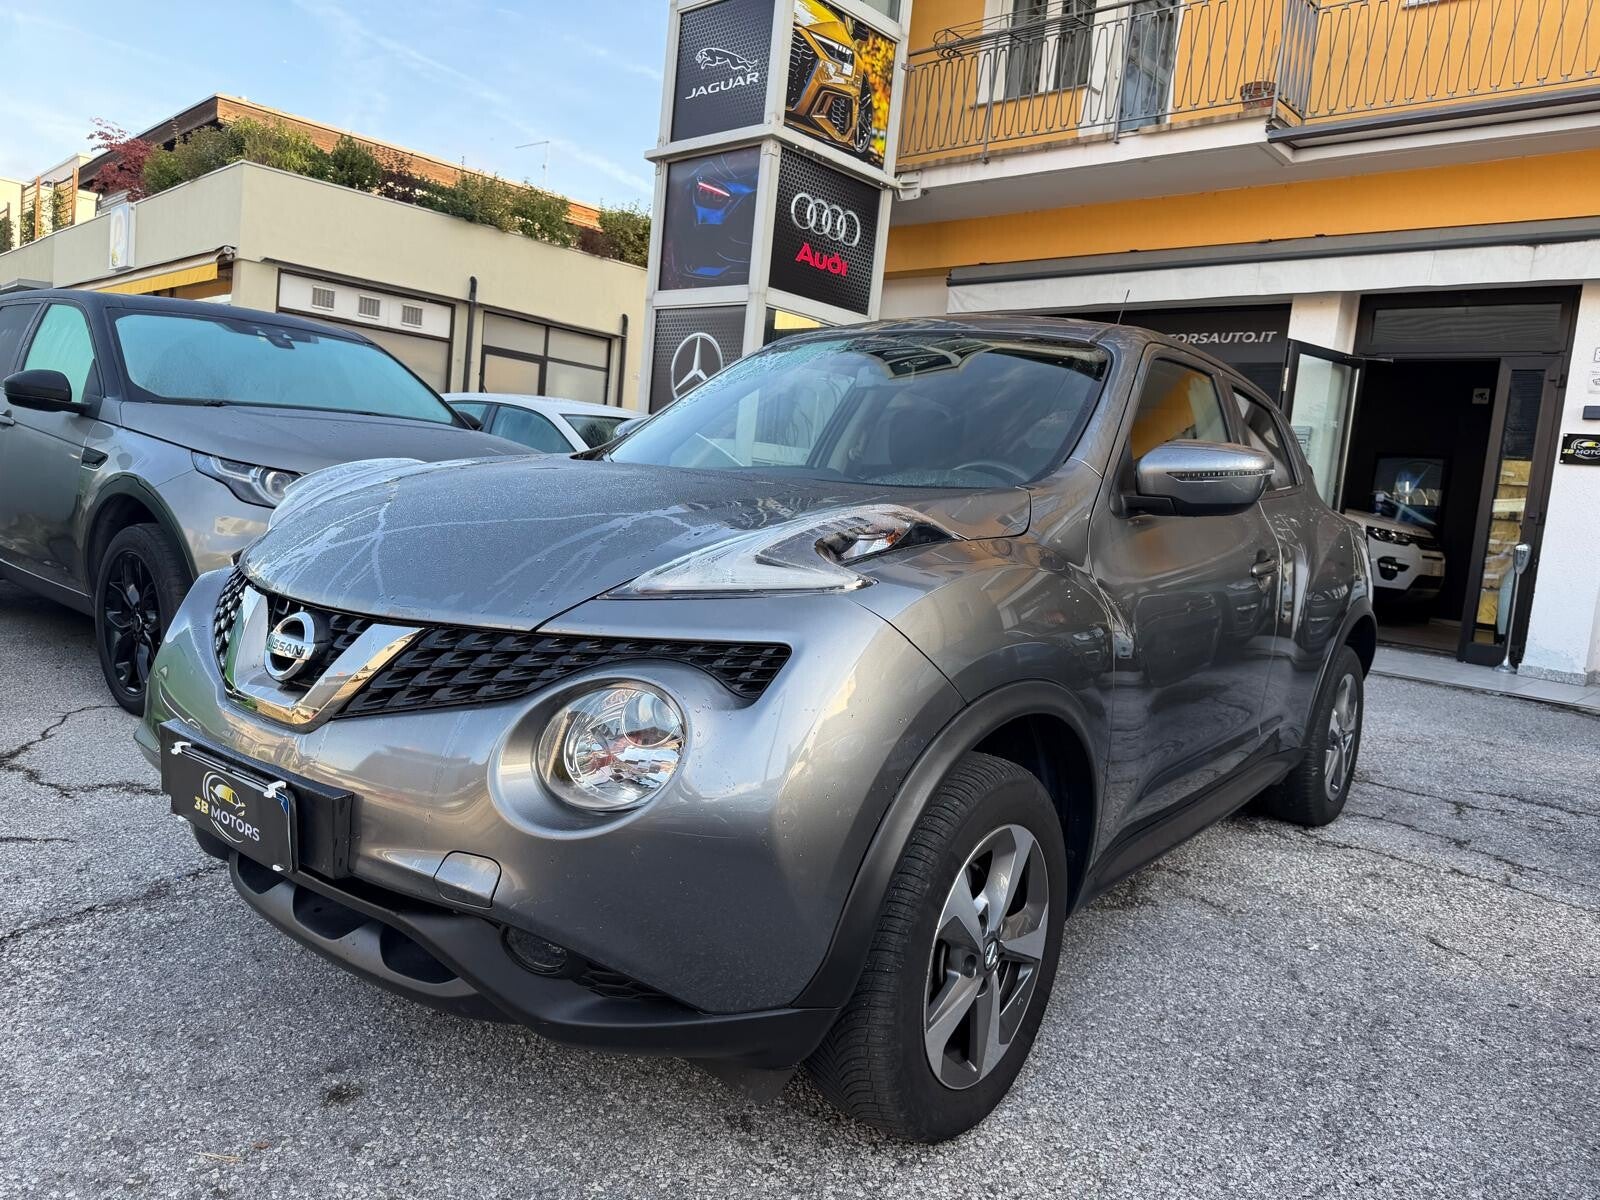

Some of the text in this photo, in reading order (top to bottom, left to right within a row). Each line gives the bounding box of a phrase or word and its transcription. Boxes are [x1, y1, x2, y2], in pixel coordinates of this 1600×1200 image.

[685, 72, 759, 100] JAGUAR
[795, 242, 848, 277] Audi
[268, 634, 306, 658] NISSAN
[193, 796, 260, 842] 3B MOTORS
